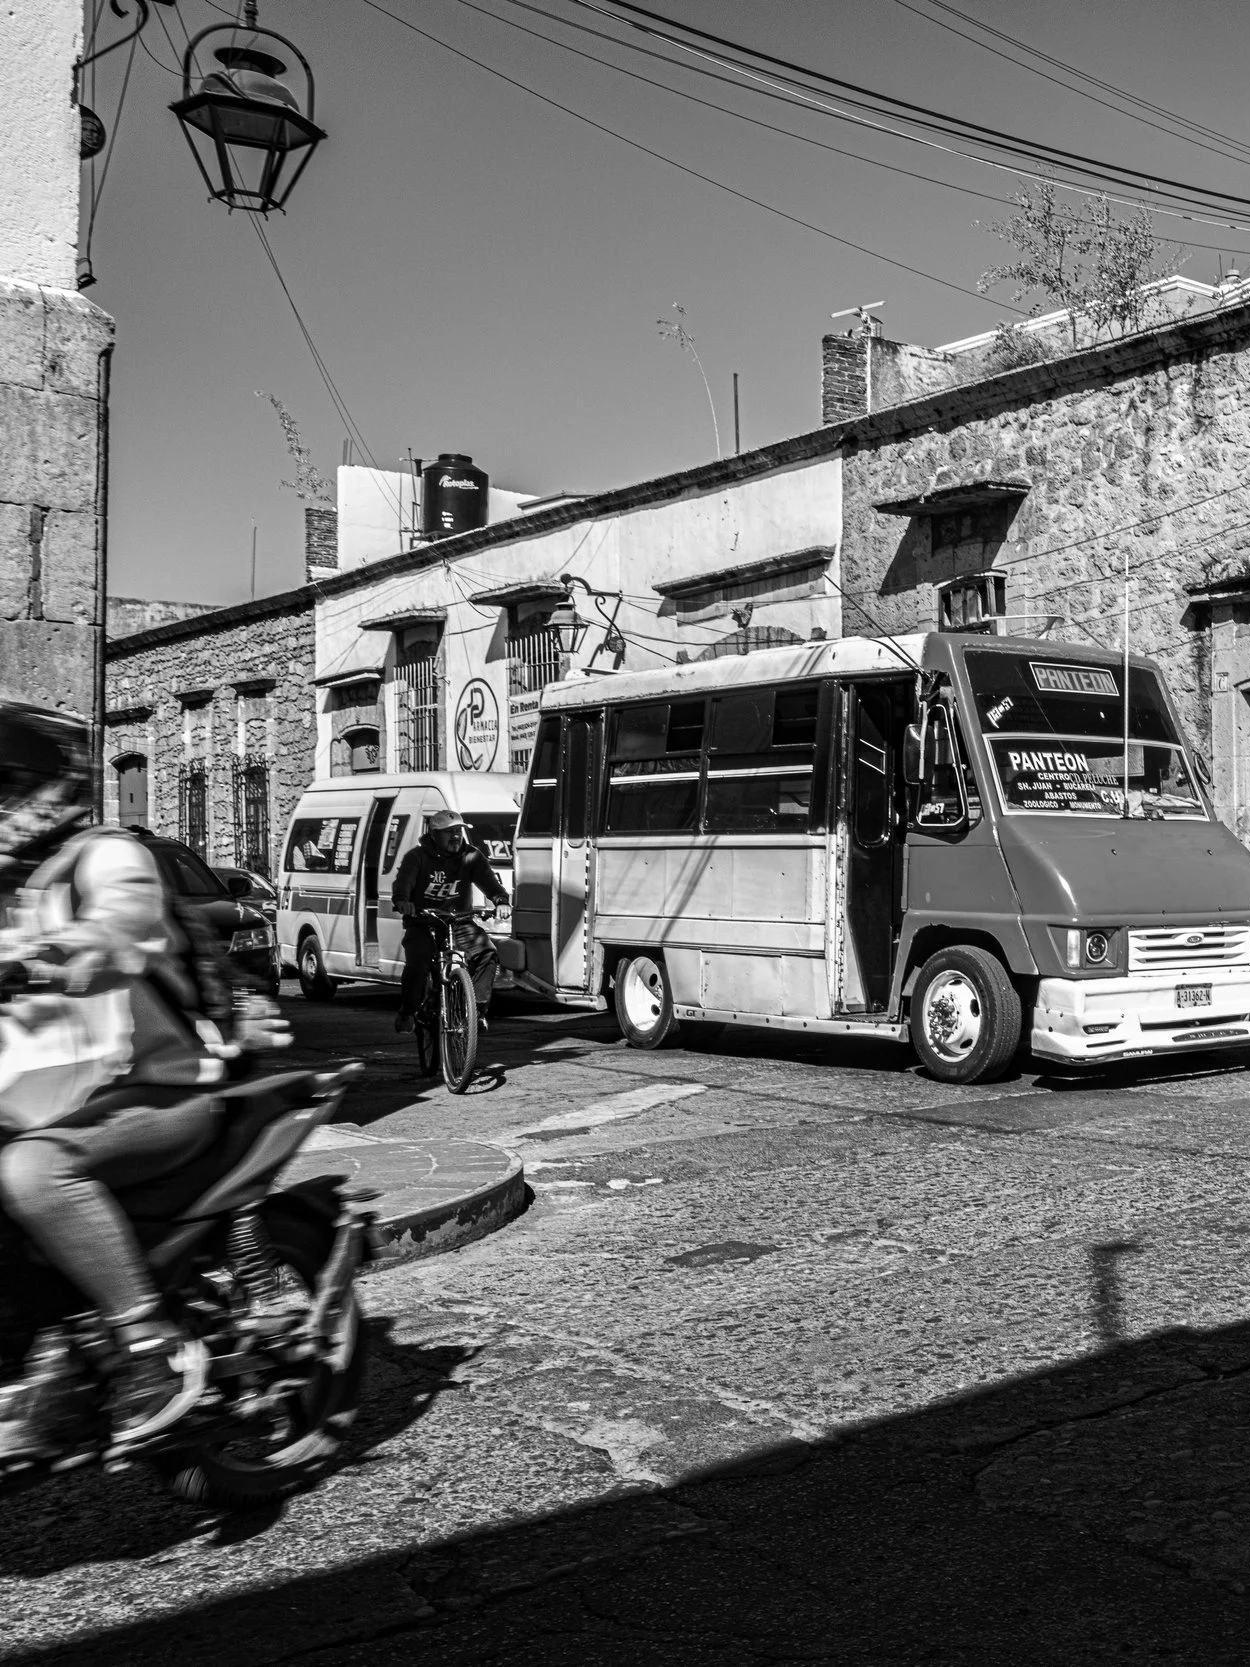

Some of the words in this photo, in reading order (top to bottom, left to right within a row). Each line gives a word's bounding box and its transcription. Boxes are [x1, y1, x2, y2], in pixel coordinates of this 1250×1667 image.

[1034, 667, 1117, 693] PANTEON
[510, 703, 519, 714] En
[519, 700, 539, 713] Renta
[1008, 751, 1090, 772] PANTEON
[1037, 772, 1070, 780] CENTRO
[1044, 792, 1077, 800] ABASTOS
